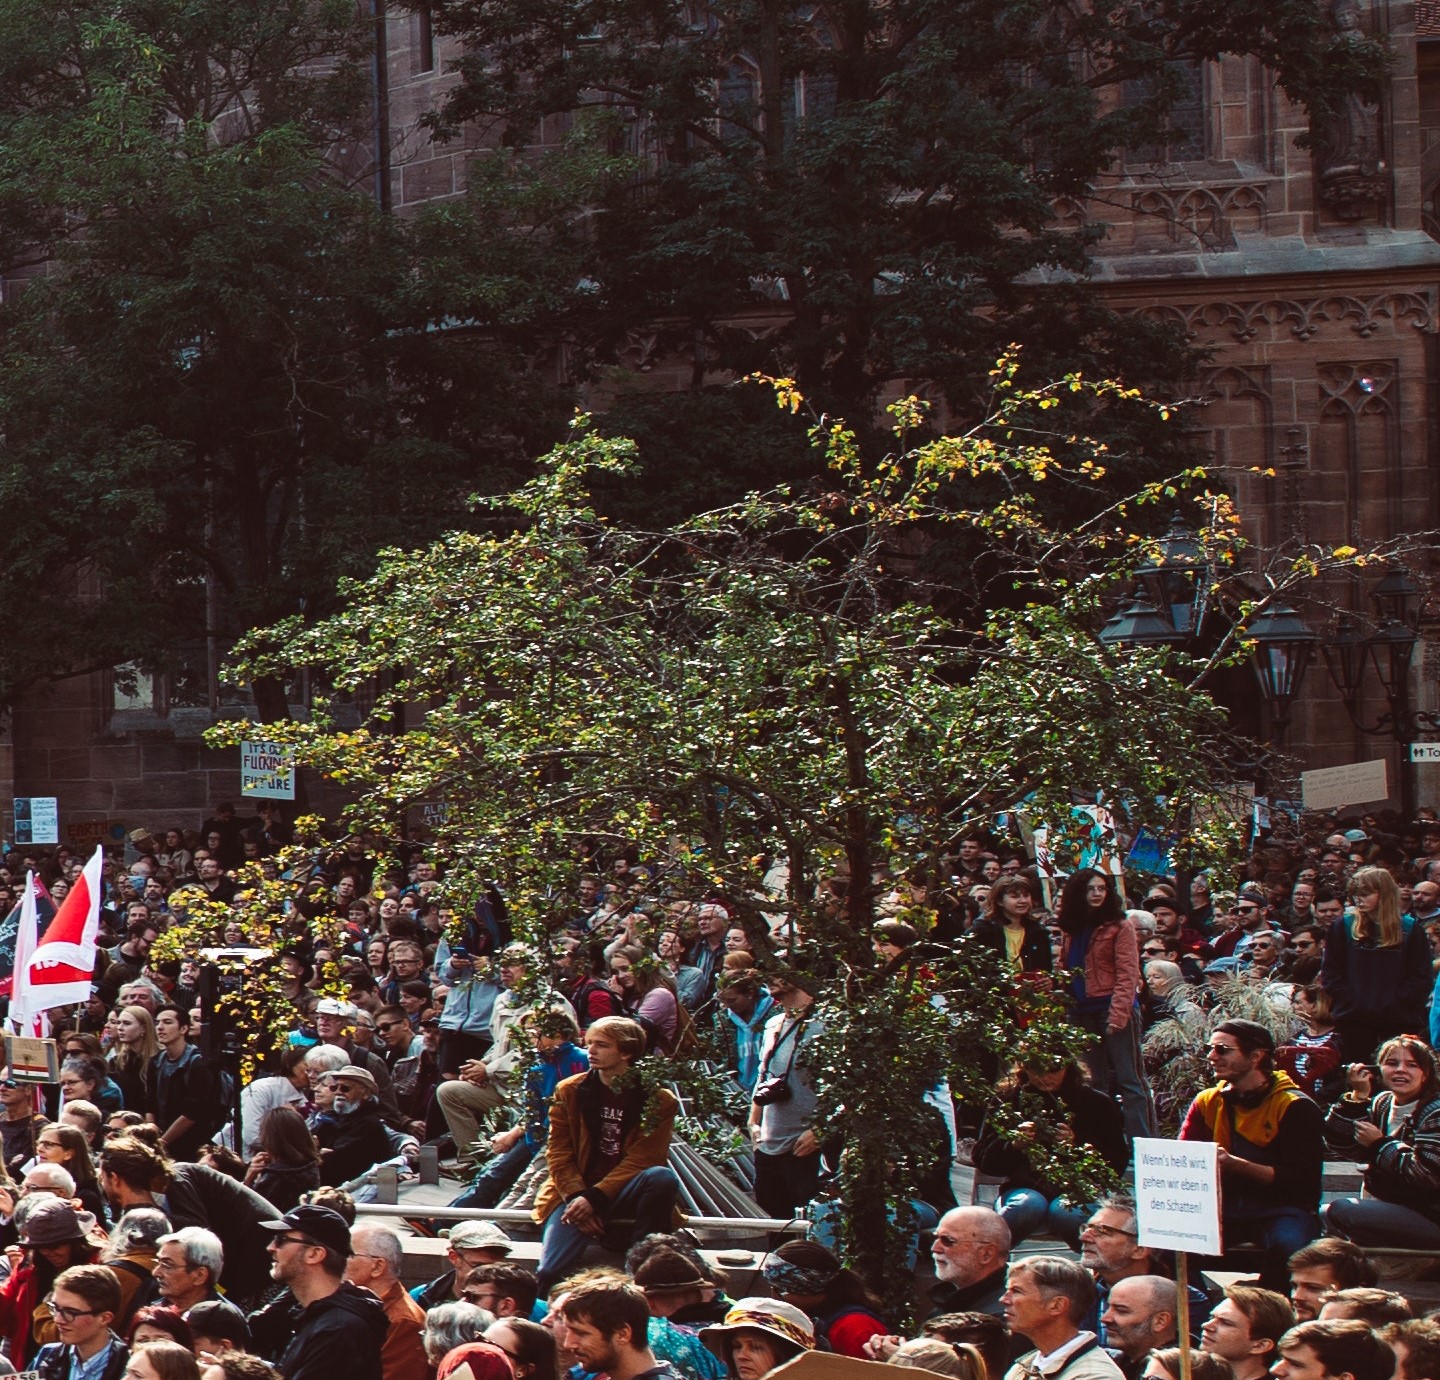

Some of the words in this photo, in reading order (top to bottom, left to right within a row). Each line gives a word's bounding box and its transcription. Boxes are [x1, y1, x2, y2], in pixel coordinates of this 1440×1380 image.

[1141, 1153, 1170, 1166] Wenn's
[1171, 1155, 1188, 1168] heiß
[1142, 1178, 1166, 1192] gehen
[1168, 1179, 1180, 1190] wir
[1181, 1180, 1199, 1192] eben
[1201, 1182, 1209, 1192] in
[1150, 1197, 1166, 1209] den
[1167, 1199, 1202, 1214] Schatten!
